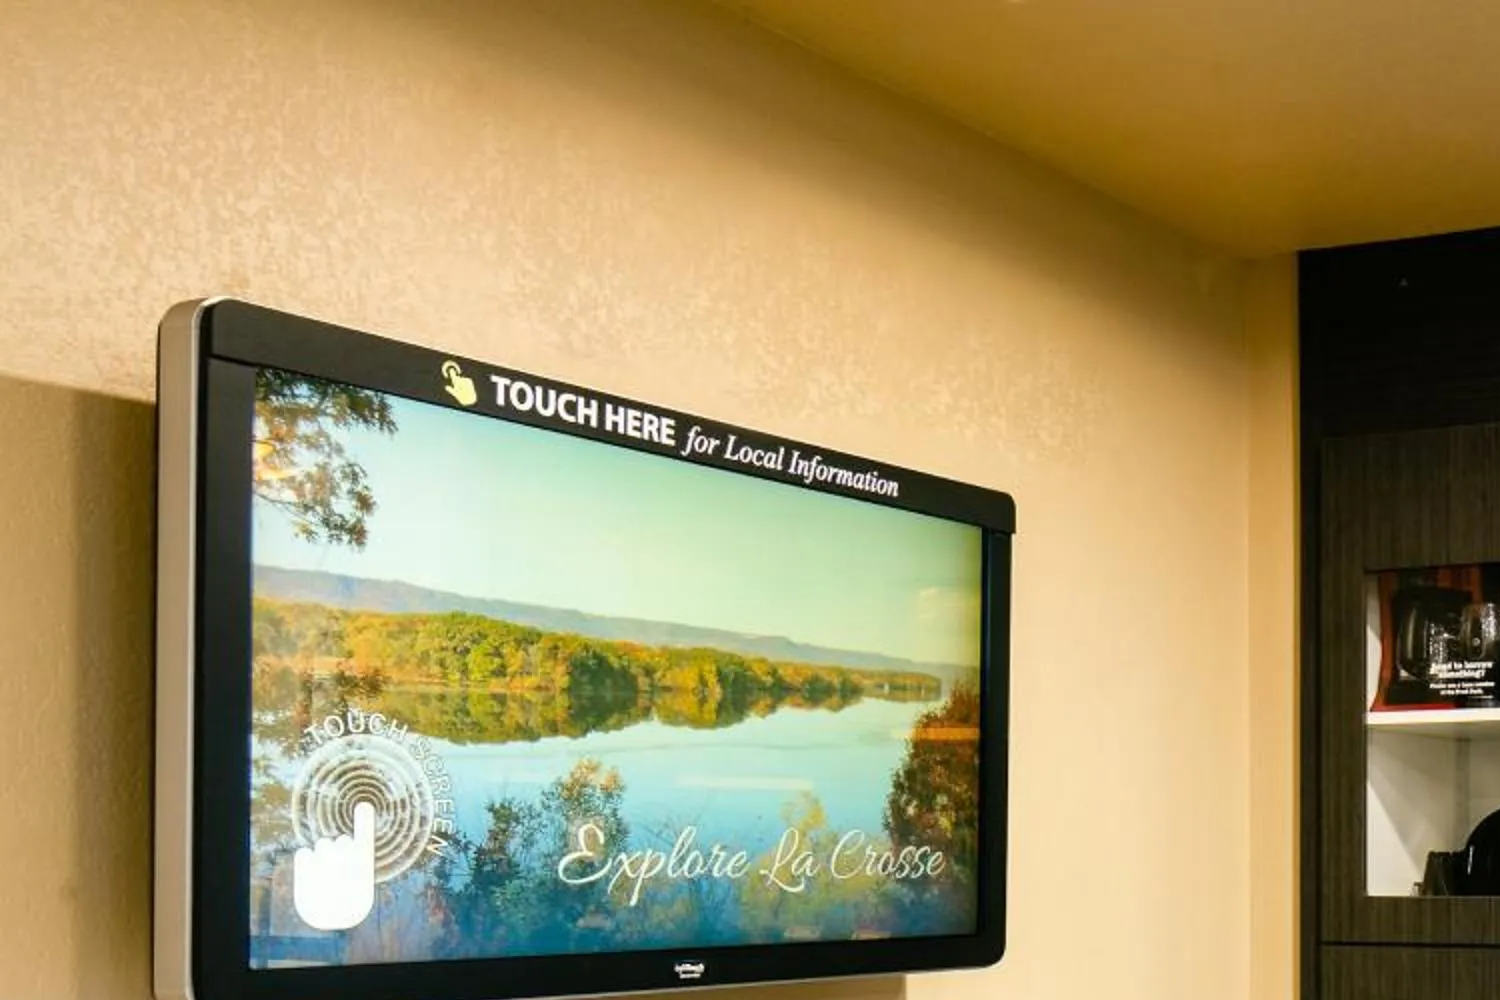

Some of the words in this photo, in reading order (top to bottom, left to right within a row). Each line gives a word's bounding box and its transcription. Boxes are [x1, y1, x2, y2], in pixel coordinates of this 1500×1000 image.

[490, 375, 598, 427] TOUCH
[605, 403, 676, 447] HERE
[681, 426, 720, 456] for
[724, 435, 783, 471] Local
[788, 449, 899, 498] Information
[304, 711, 408, 745] TOUCH
[411, 735, 454, 857] SCREEN
[557, 823, 752, 906] Explore
[759, 827, 818, 893] La
[830, 828, 946, 880] Crosse
